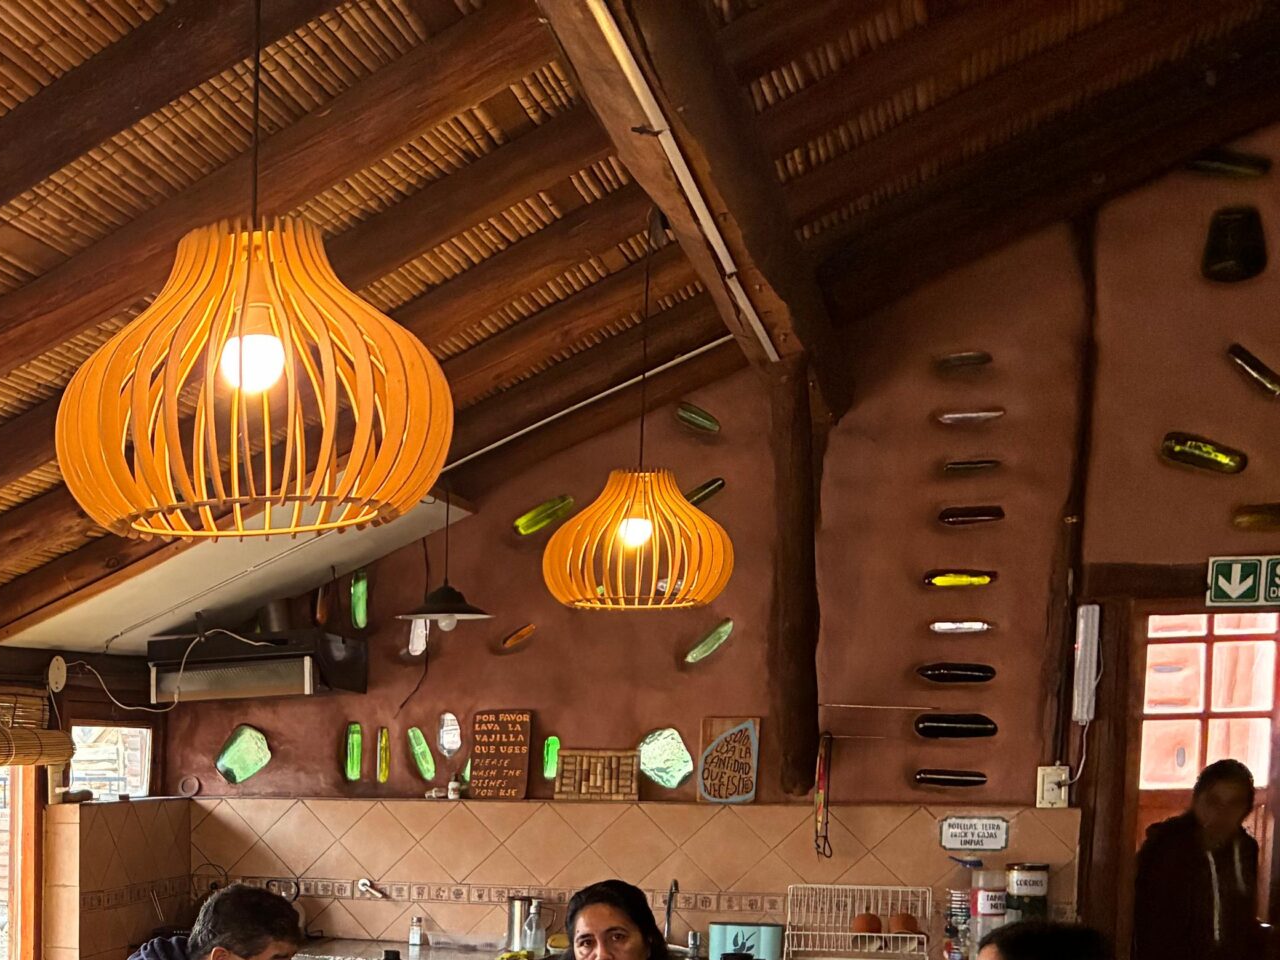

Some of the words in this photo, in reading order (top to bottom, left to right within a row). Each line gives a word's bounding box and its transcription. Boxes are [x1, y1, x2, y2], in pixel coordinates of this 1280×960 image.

[476, 714, 495, 722] POR
[499, 713, 530, 722] FAVOR
[474, 723, 500, 731] LAVA
[508, 723, 522, 731] LA
[475, 734, 524, 742] VAJILLA
[474, 745, 496, 753] QUE
[500, 745, 528, 754] USES
[739, 746, 752, 759] LA
[473, 758, 511, 767] PLEASE
[704, 753, 751, 776] CANTIDAD
[472, 769, 497, 777] WASH
[503, 769, 522, 777] THE
[471, 779, 508, 787] DISHES
[474, 788, 494, 796] YOU
[499, 788, 518, 797] USE
